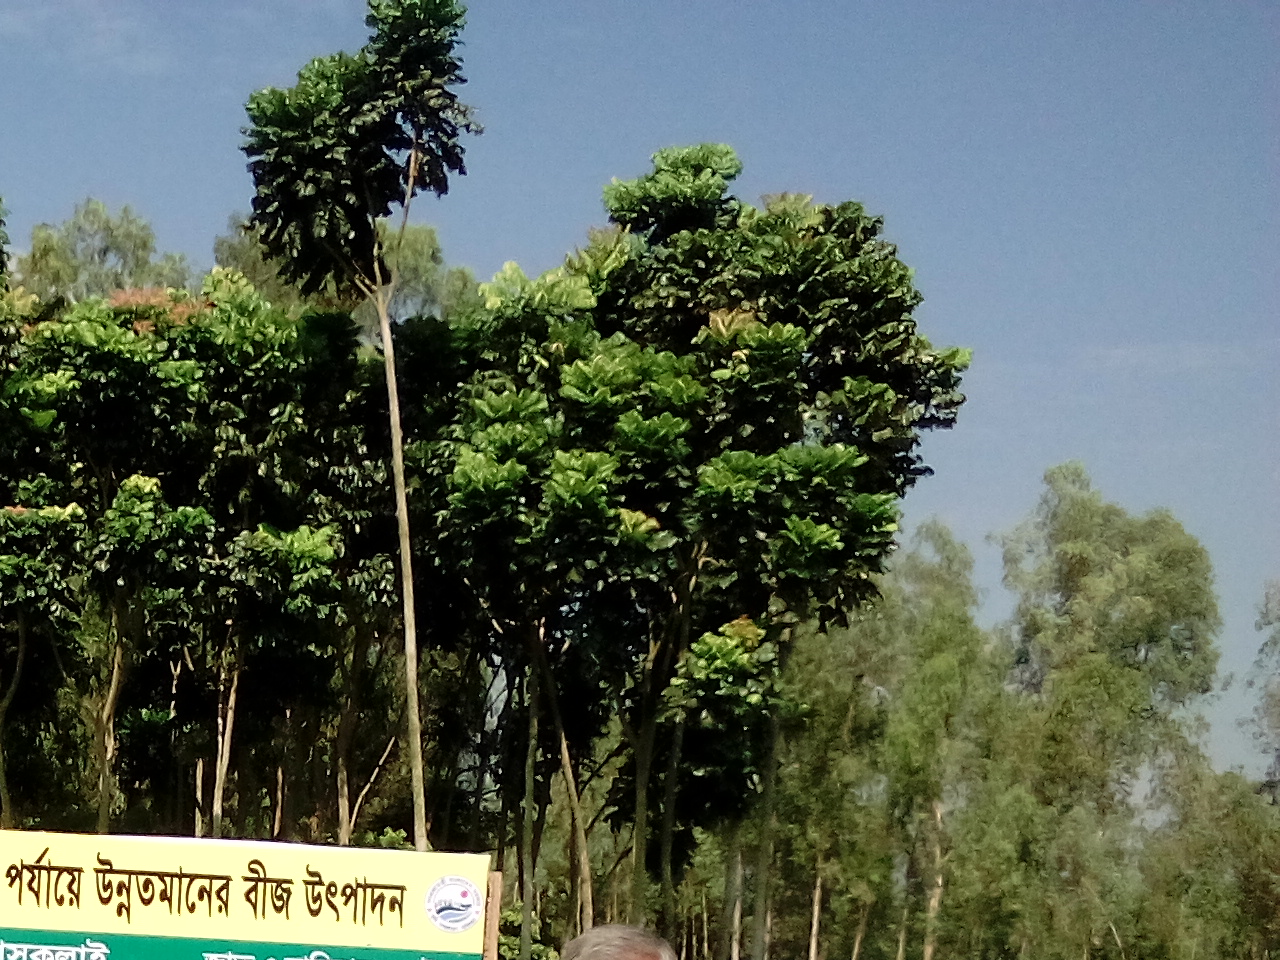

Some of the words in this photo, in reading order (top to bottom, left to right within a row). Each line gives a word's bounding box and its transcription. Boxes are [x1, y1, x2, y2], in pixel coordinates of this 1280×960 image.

[5, 847, 84, 910] পর্যায়ে
[93, 852, 233, 924] উন্নতমানের
[242, 859, 294, 920] বীজ
[302, 864, 407, 928] উৎপাদন
